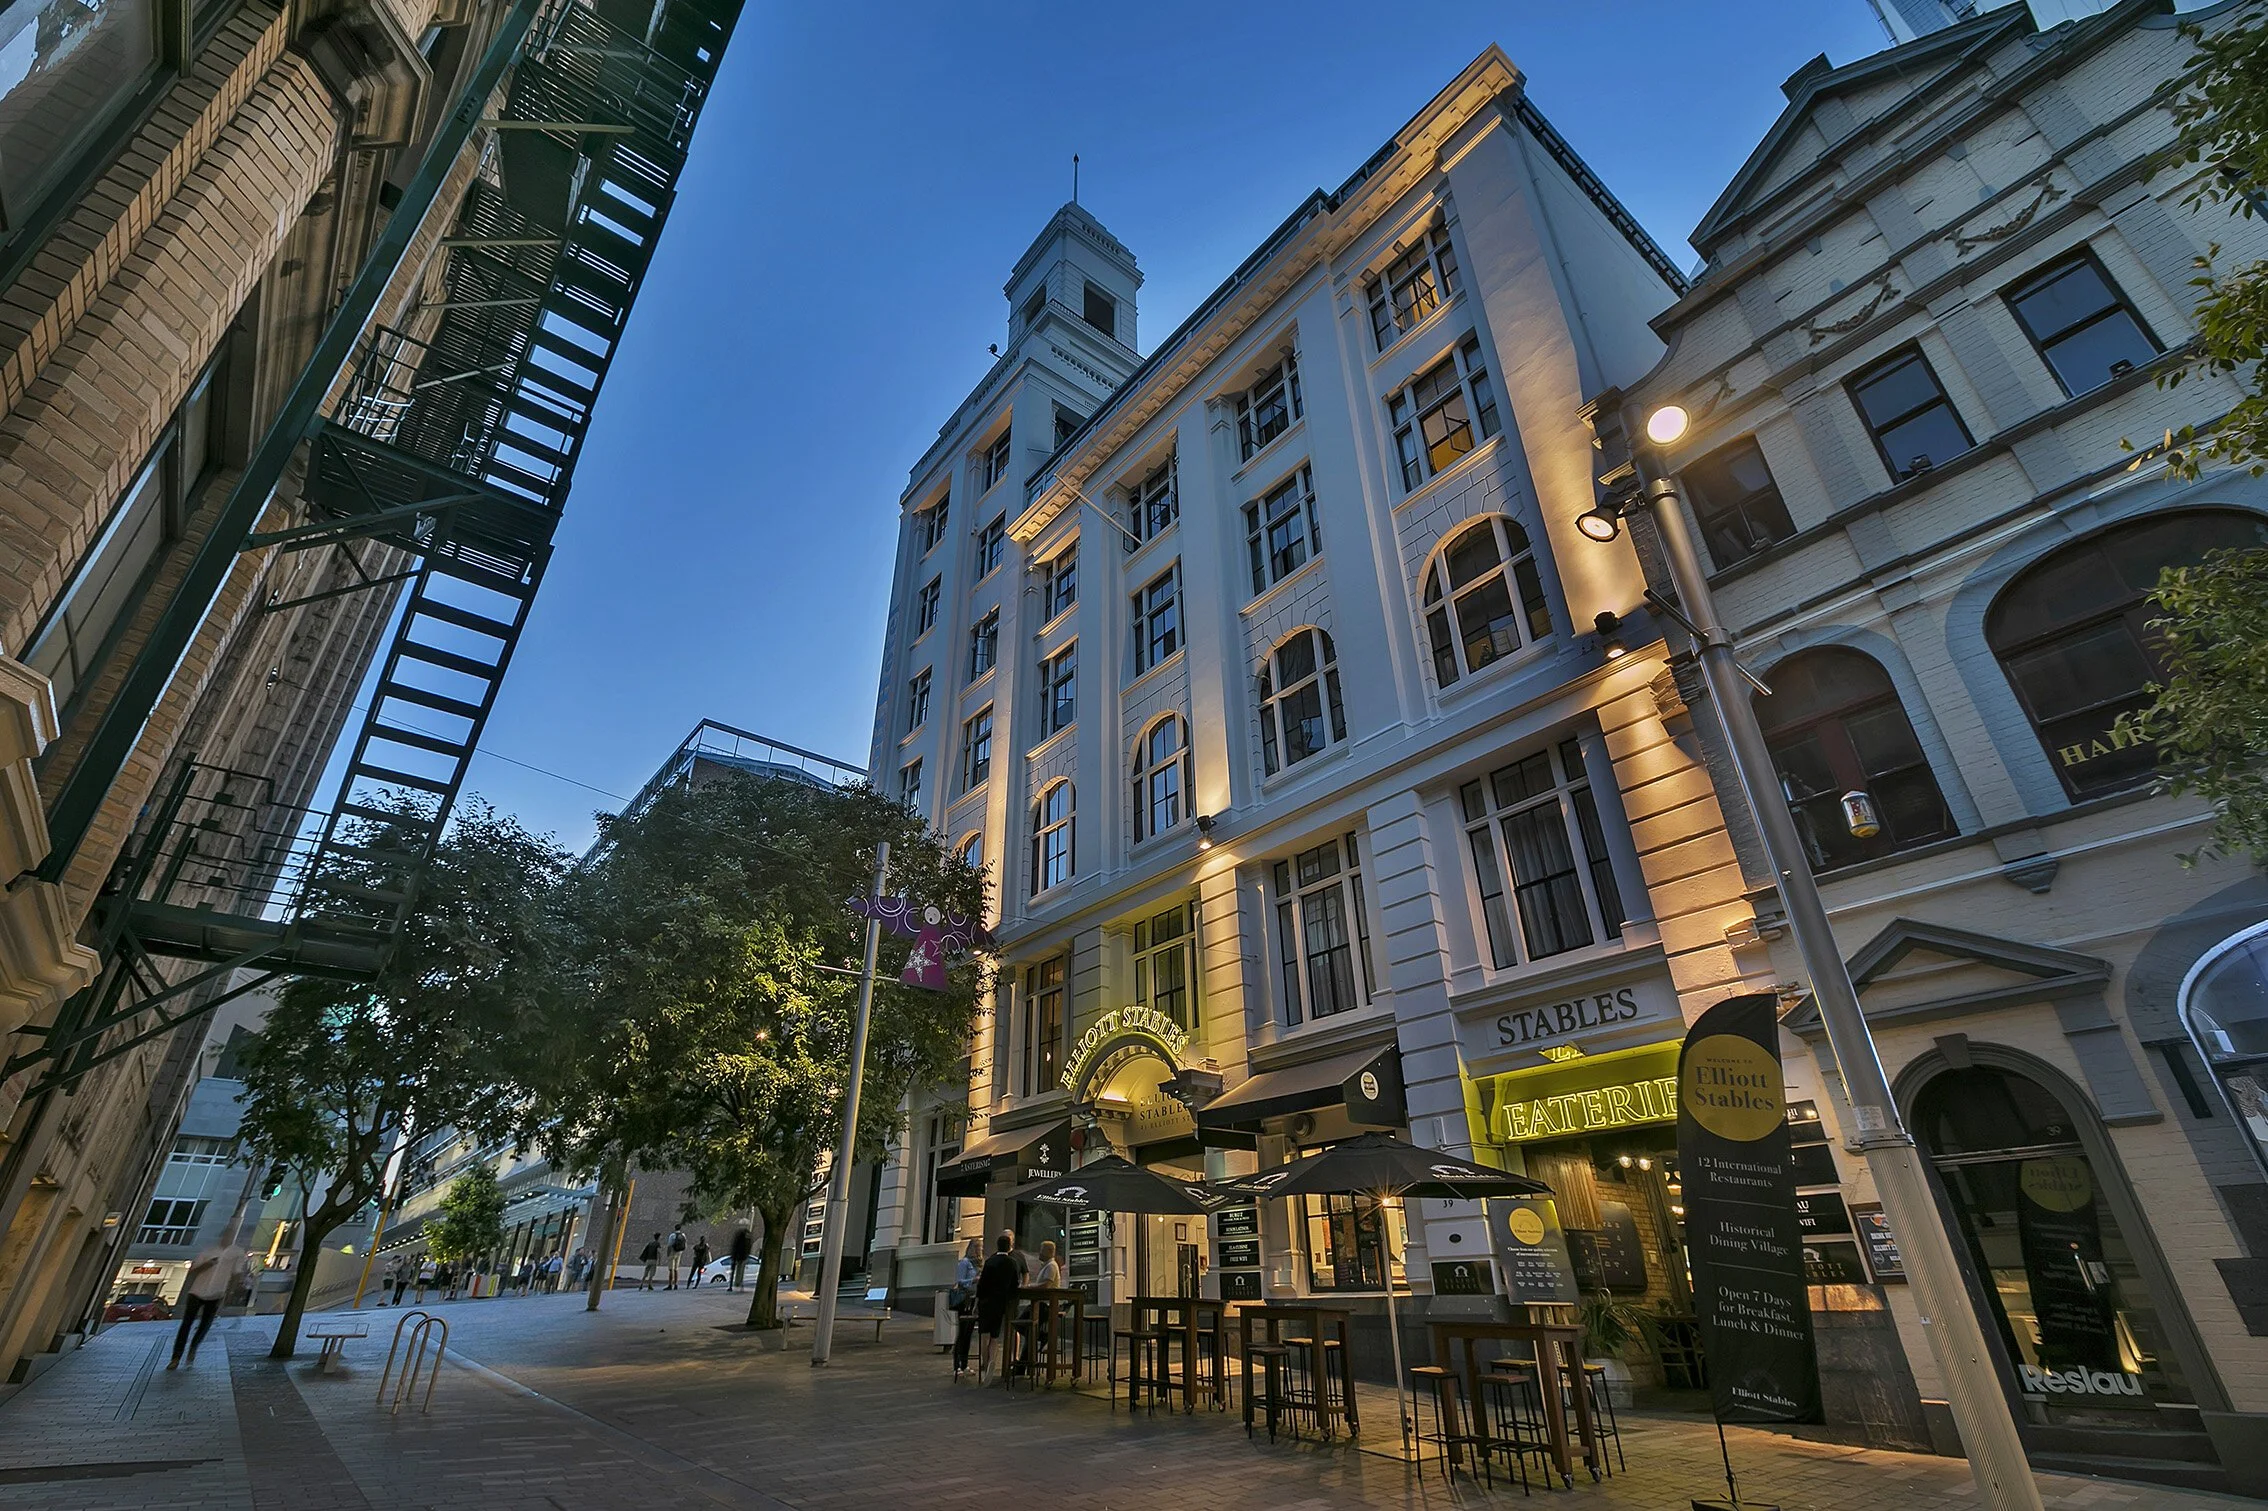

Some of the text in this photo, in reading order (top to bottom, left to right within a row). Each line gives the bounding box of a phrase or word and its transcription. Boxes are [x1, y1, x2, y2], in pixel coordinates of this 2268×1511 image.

[1496, 988, 1638, 1045] STABLES
[1060, 1006, 1189, 1091] ELLIOTT STABLES
[1696, 1066, 1768, 1089] Elliott
[1140, 1092, 1172, 1107] ELLIO
[1503, 1076, 1678, 1140] EATERIE
[1694, 1087, 1774, 1111] Stables
[2046, 1125, 2061, 1136] 39
[1028, 1168, 1062, 1179] JEWELLERY
[1698, 1157, 1782, 1175] 12 International
[1710, 1172, 1773, 1188] Restaurants
[1443, 1199, 1454, 1208] 39
[1720, 1221, 1775, 1238] Historical
[1710, 1234, 1789, 1257] Dining Village
[1719, 1286, 1792, 1309] Open 7 Days
[1719, 1301, 1735, 1313] for
[1713, 1315, 1804, 1341] Lunch & Dinner
[2018, 1364, 2144, 1396] Reslau
[1732, 1386, 1798, 1407] Elliott Stables
